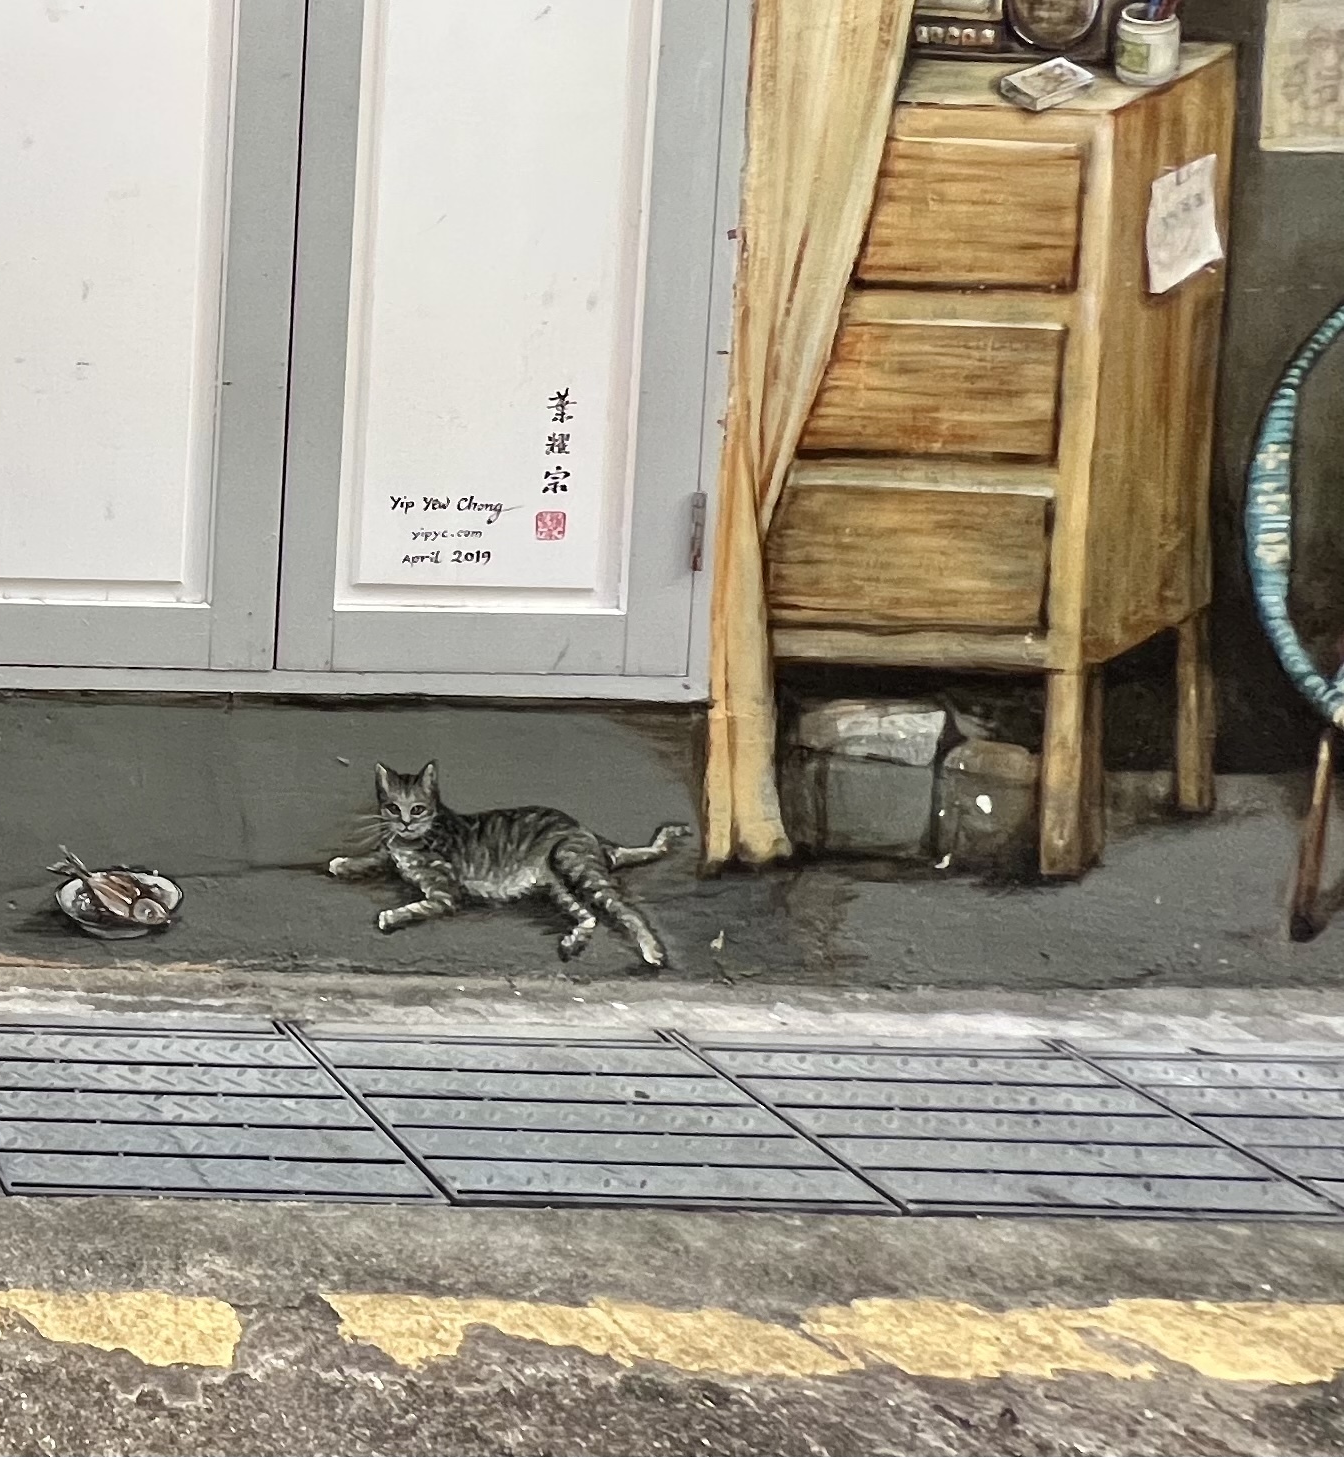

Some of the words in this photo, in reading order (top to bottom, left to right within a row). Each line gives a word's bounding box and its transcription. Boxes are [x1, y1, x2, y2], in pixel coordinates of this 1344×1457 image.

[390, 496, 415, 514] Yip
[456, 495, 505, 525] Chong
[411, 528, 483, 541] yipyc.com
[451, 550, 491, 565] 2019
